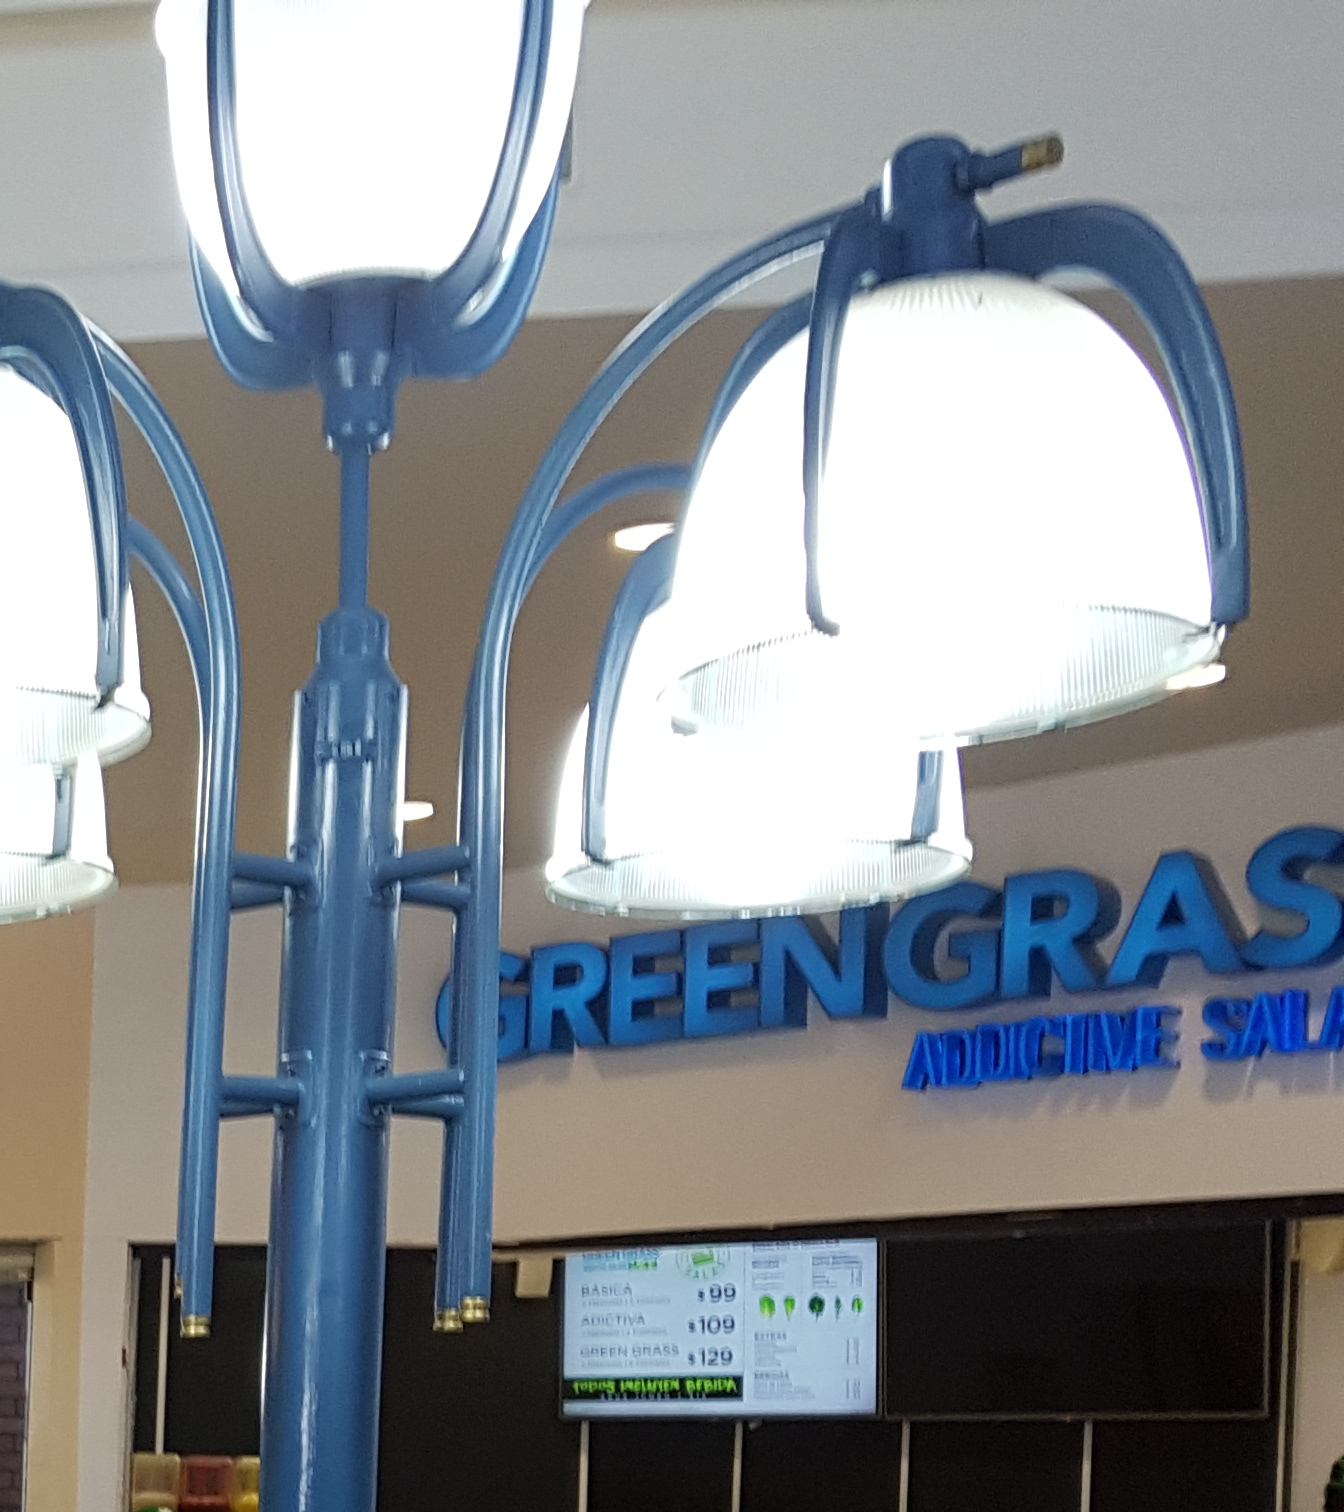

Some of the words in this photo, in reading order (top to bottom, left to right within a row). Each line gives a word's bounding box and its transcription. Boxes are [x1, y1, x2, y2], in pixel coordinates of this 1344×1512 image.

[901, 1004, 1183, 1092] ADDICTIVE
[688, 1315, 736, 1335] $109
[687, 1346, 734, 1367] $129
